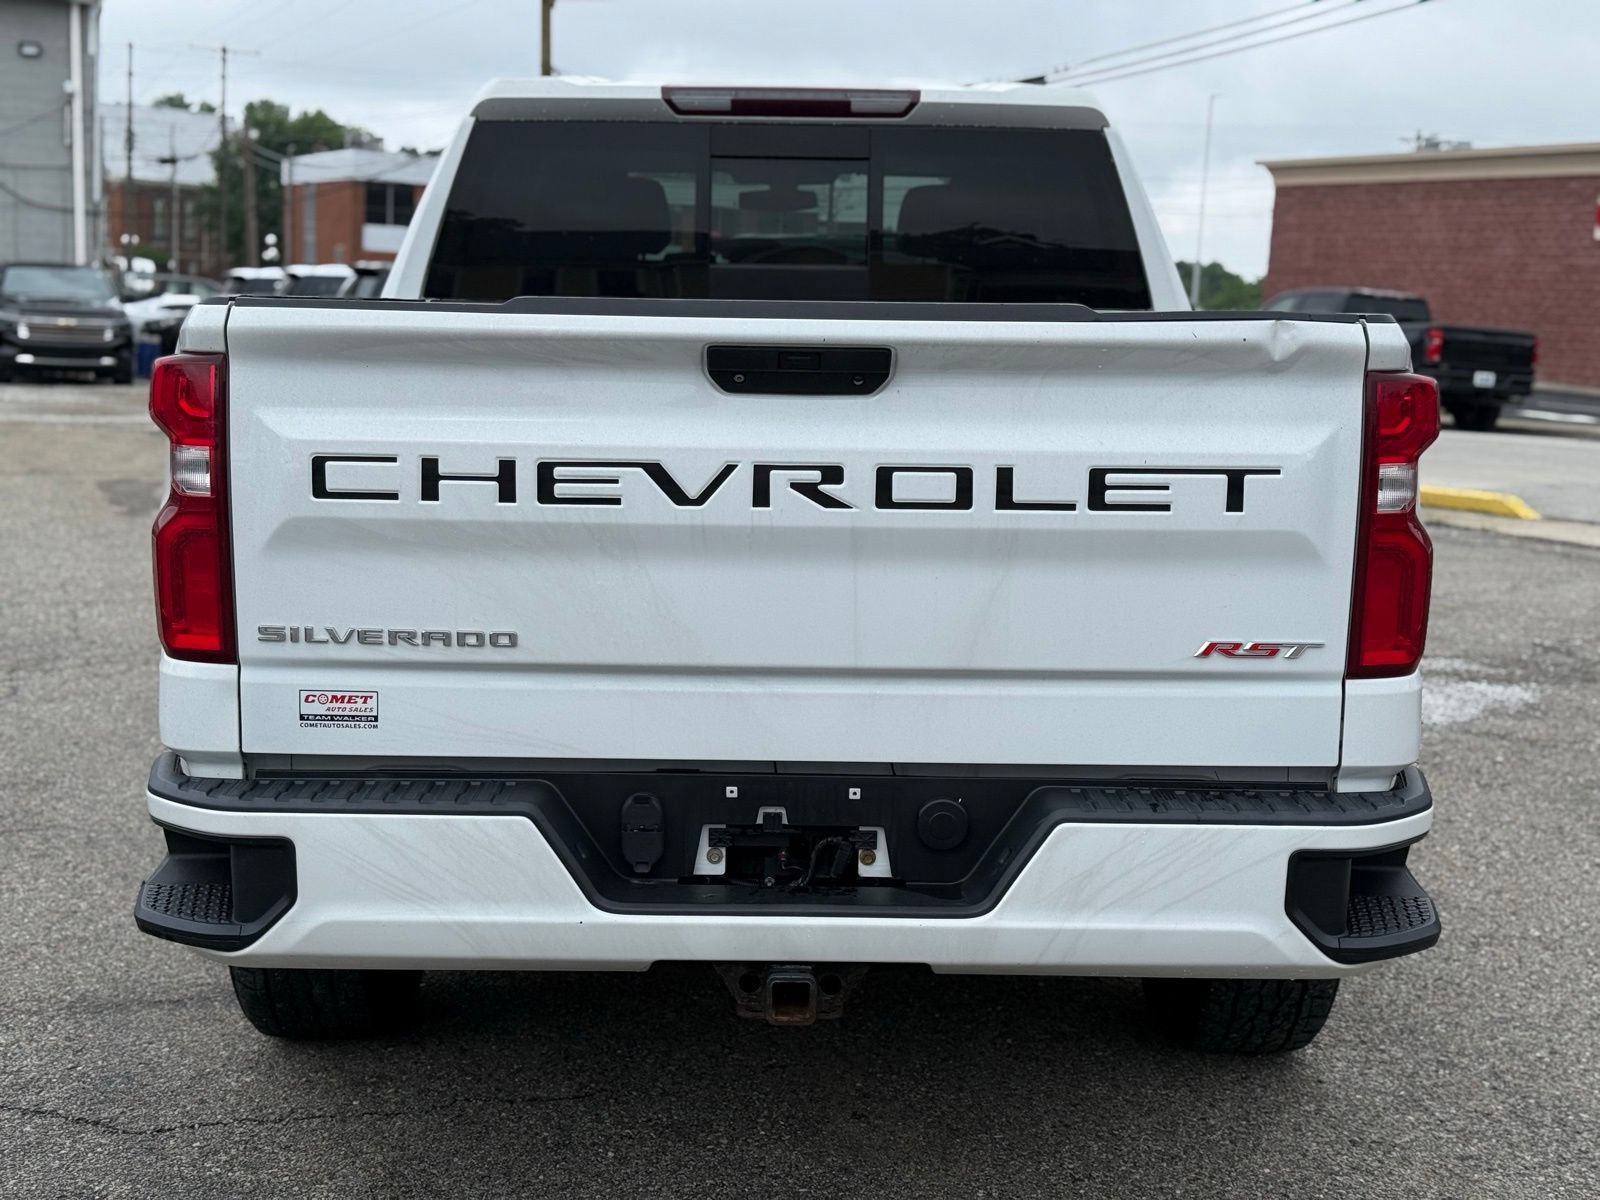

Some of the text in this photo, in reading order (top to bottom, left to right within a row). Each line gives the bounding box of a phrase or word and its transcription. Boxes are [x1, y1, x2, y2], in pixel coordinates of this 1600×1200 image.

[311, 455, 1281, 513] CHEVROLET
[257, 624, 518, 648] SILVERADO
[1193, 641, 1325, 658] RST
[304, 693, 374, 705] COMET
